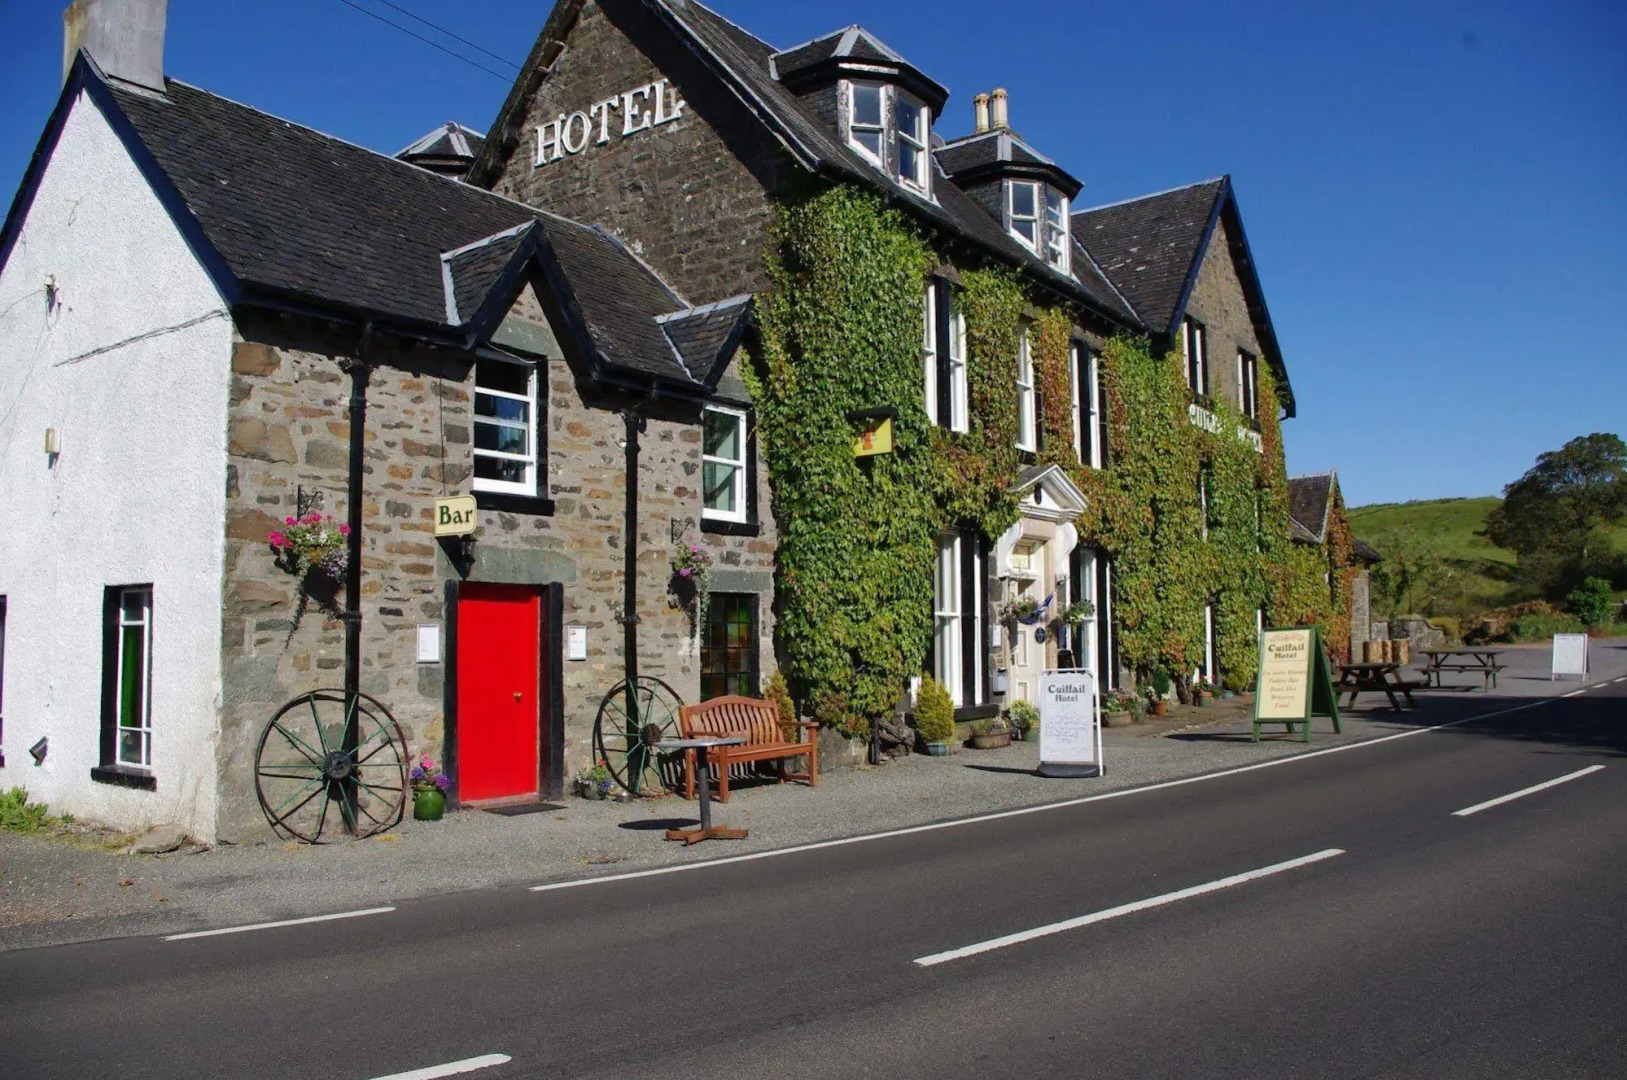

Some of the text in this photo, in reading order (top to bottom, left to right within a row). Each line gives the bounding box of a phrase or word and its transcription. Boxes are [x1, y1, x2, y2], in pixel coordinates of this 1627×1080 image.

[535, 79, 686, 167] HOTEL
[439, 505, 473, 525] Bar
[1268, 643, 1304, 652] Cuilfail
[1048, 684, 1085, 694] Cuilfail
